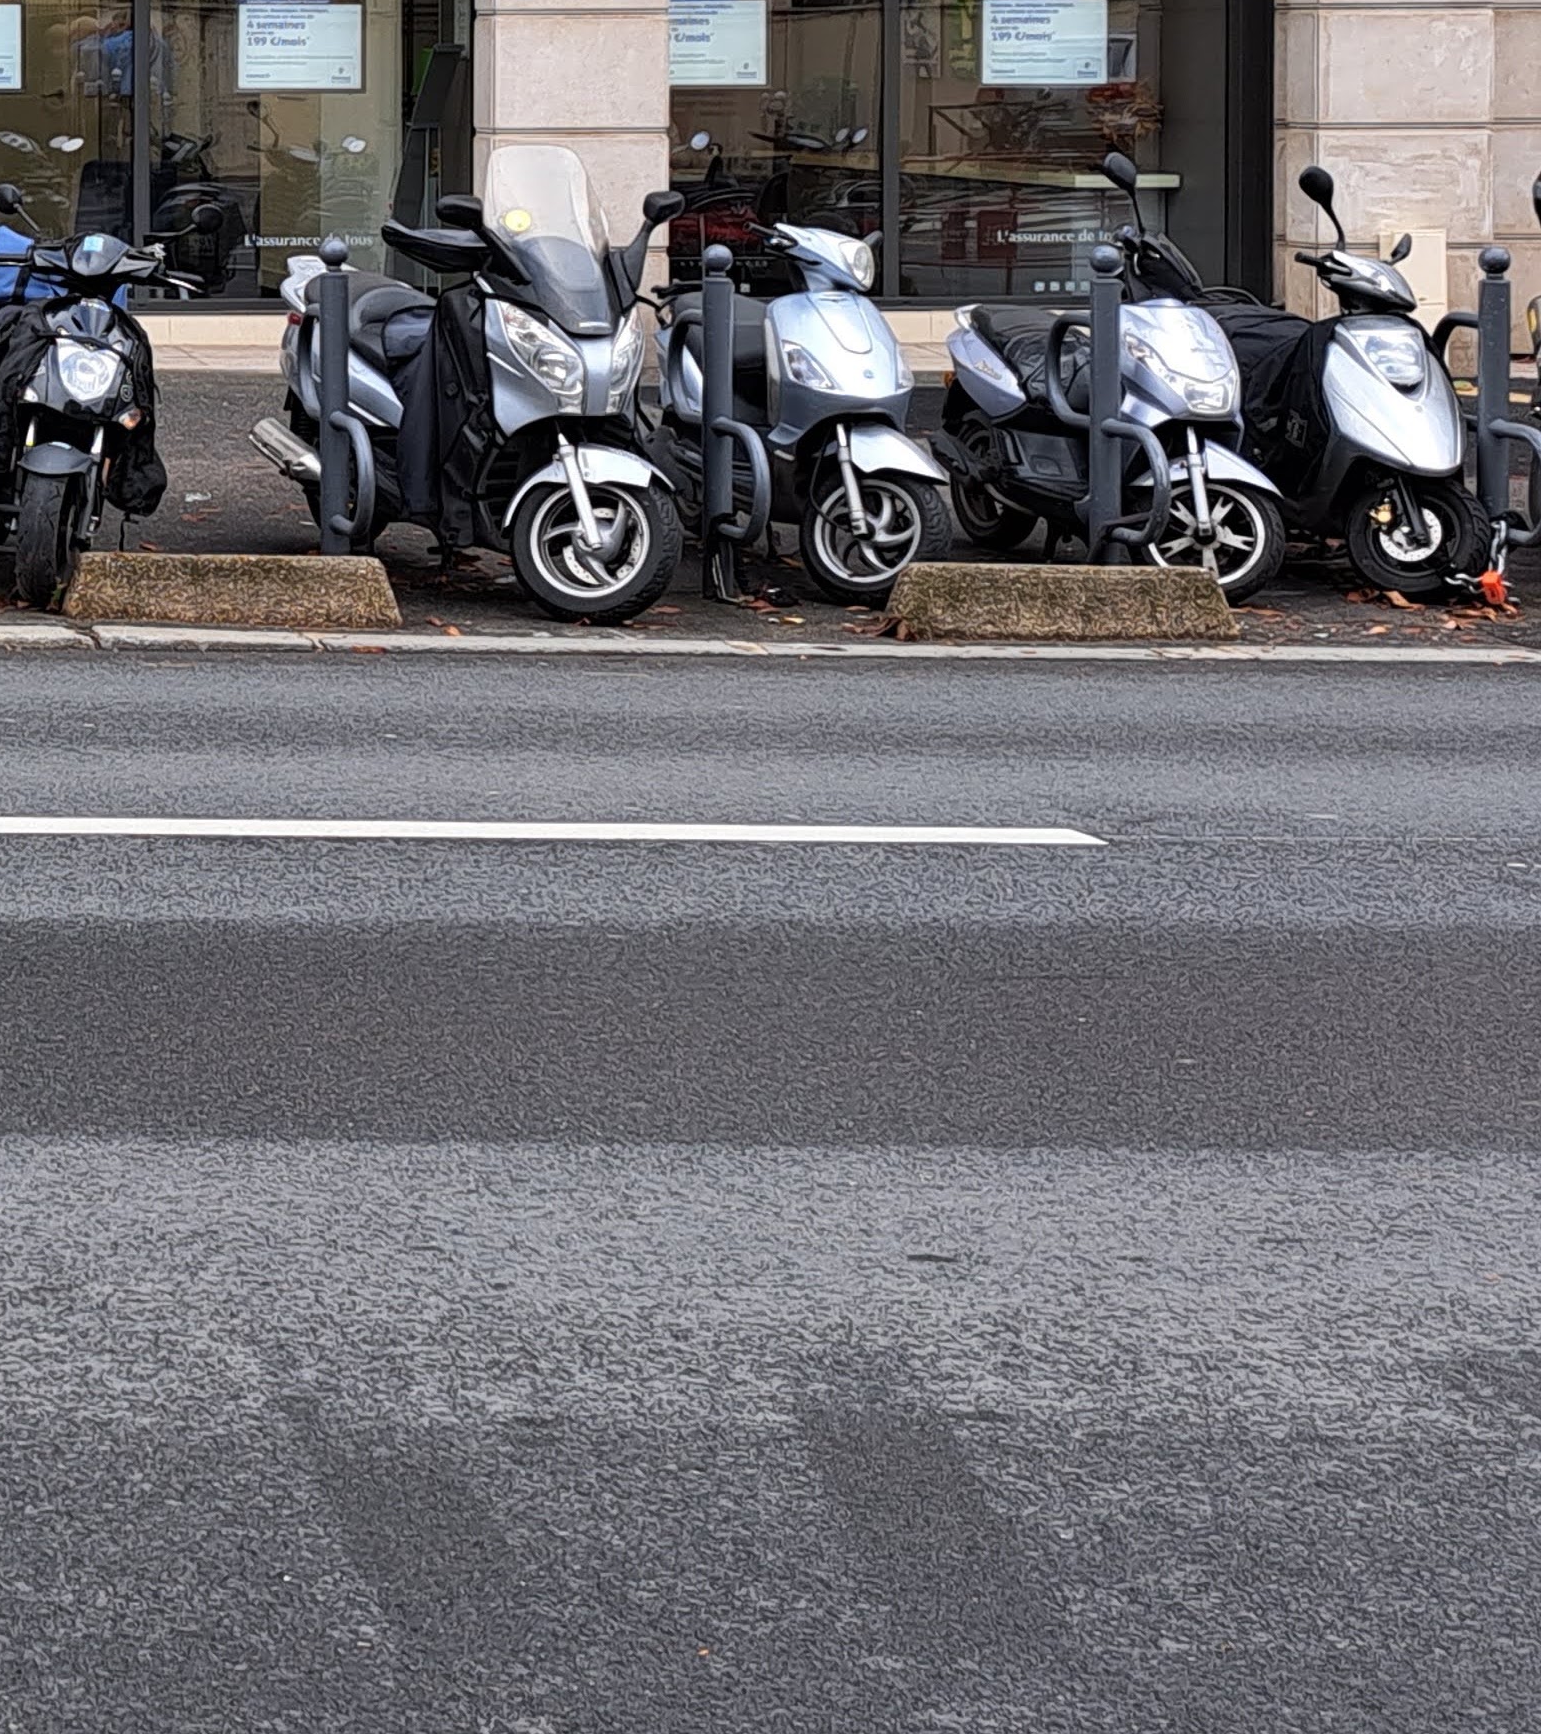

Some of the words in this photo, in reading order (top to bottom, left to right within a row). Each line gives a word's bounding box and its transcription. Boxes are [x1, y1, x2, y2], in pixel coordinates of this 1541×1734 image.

[244, 233, 321, 247] L'assurance
[345, 233, 374, 246] tous
[996, 229, 1075, 243] L'assurance
[1078, 228, 1095, 242] de
